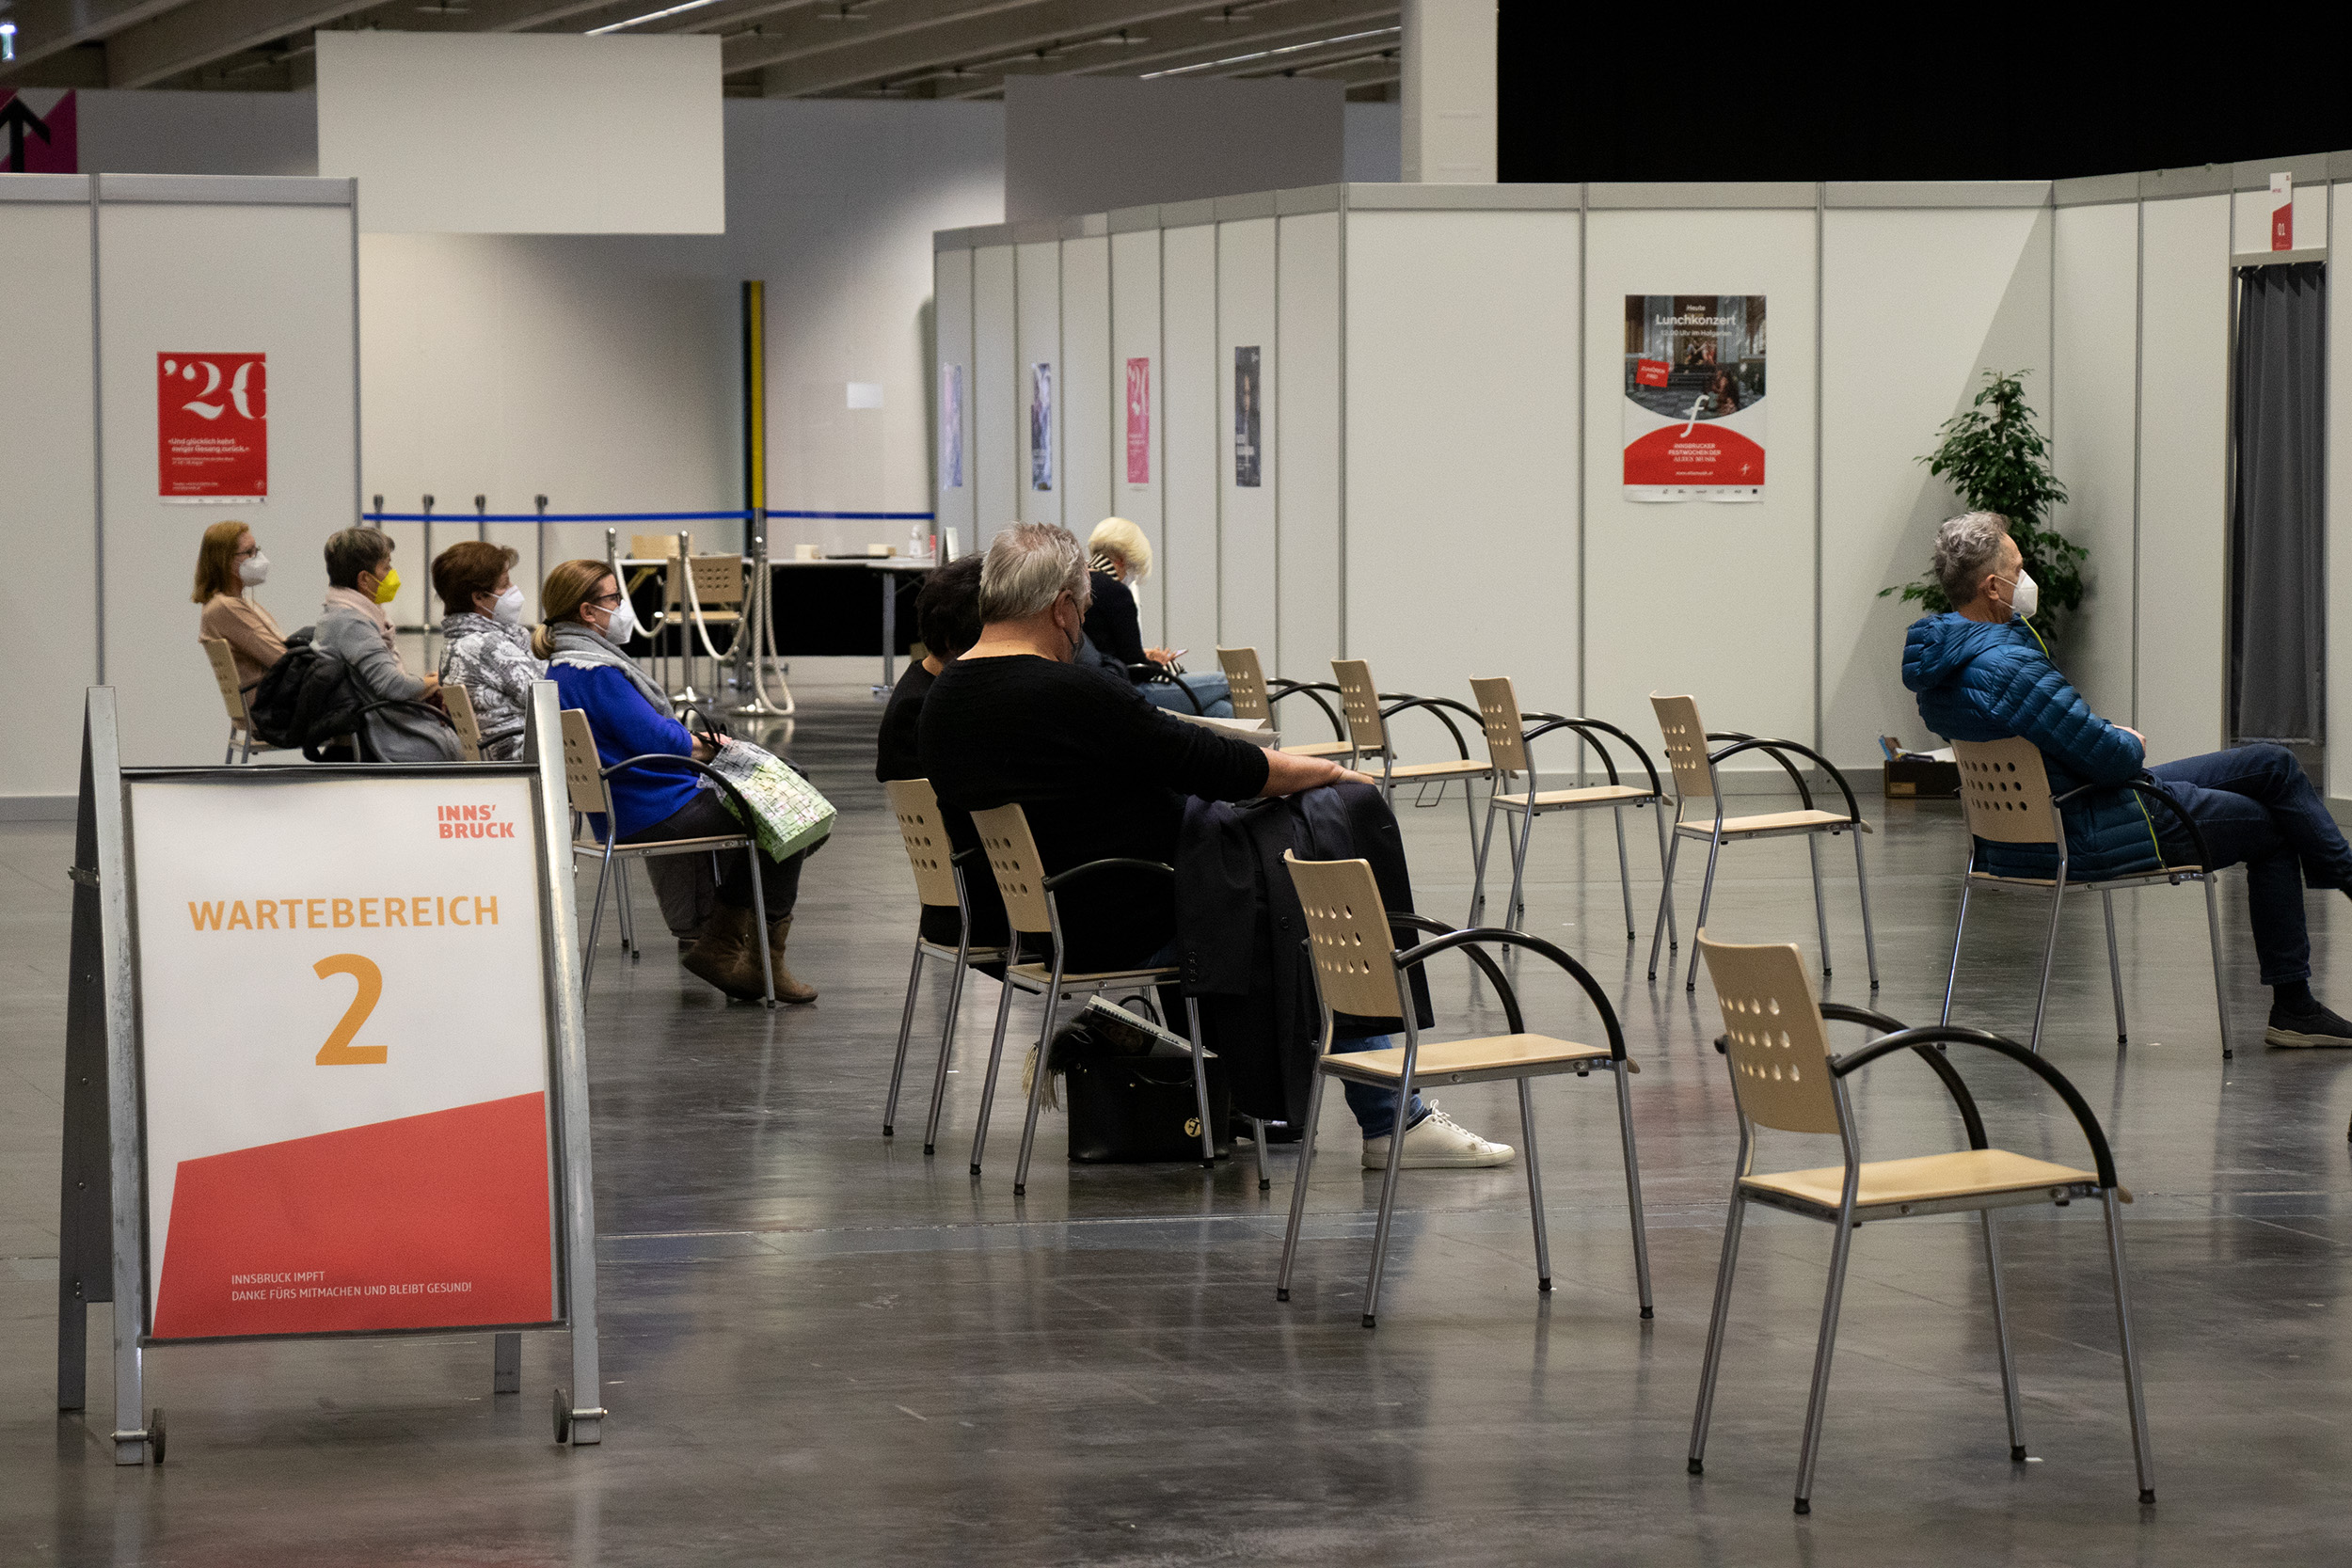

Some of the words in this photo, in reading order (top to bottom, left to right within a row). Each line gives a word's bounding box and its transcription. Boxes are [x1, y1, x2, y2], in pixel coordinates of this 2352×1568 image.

[2278, 223, 2285, 236] 01
[1656, 313, 1737, 325] Lunchkonzert
[1701, 329, 1732, 338] Hofgarten
[186, 437, 216, 446] glücklich
[195, 445, 221, 453] Gesang
[437, 804, 497, 821] INNS'
[438, 822, 516, 839] BRUCK
[187, 895, 499, 931] WARTEBEREICH
[312, 953, 388, 1066] 2
[231, 1273, 292, 1285] INNSBRUCK
[294, 1271, 326, 1282] IMPFT
[231, 1290, 267, 1301] DANKE
[269, 1286, 297, 1299] FÜRS
[299, 1286, 361, 1298] MITMACHEN
[364, 1285, 387, 1296] UND
[389, 1283, 424, 1295] BLEIBT
[427, 1281, 472, 1293] GESUND!
